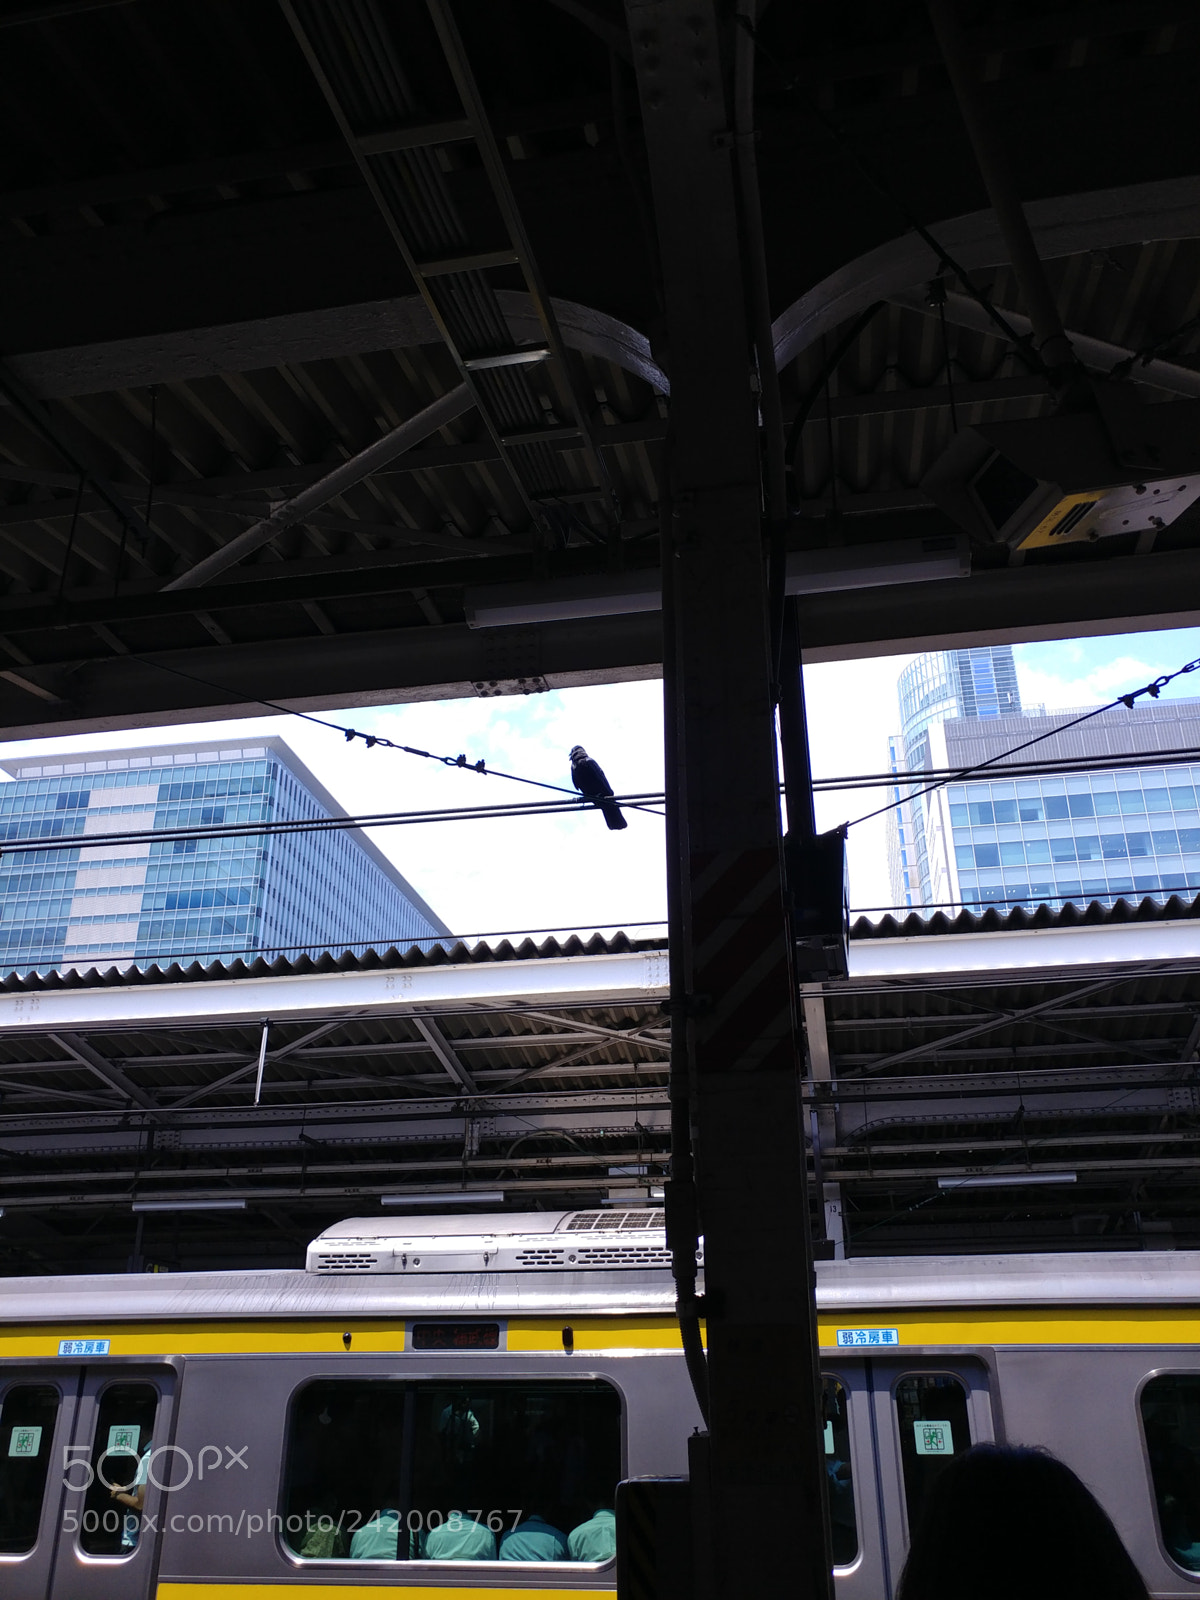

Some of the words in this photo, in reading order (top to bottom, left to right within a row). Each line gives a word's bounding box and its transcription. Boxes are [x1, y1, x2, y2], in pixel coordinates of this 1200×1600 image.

[842, 1330, 894, 1344] 弱冷房車
[62, 1341, 106, 1354] 弱冷房車
